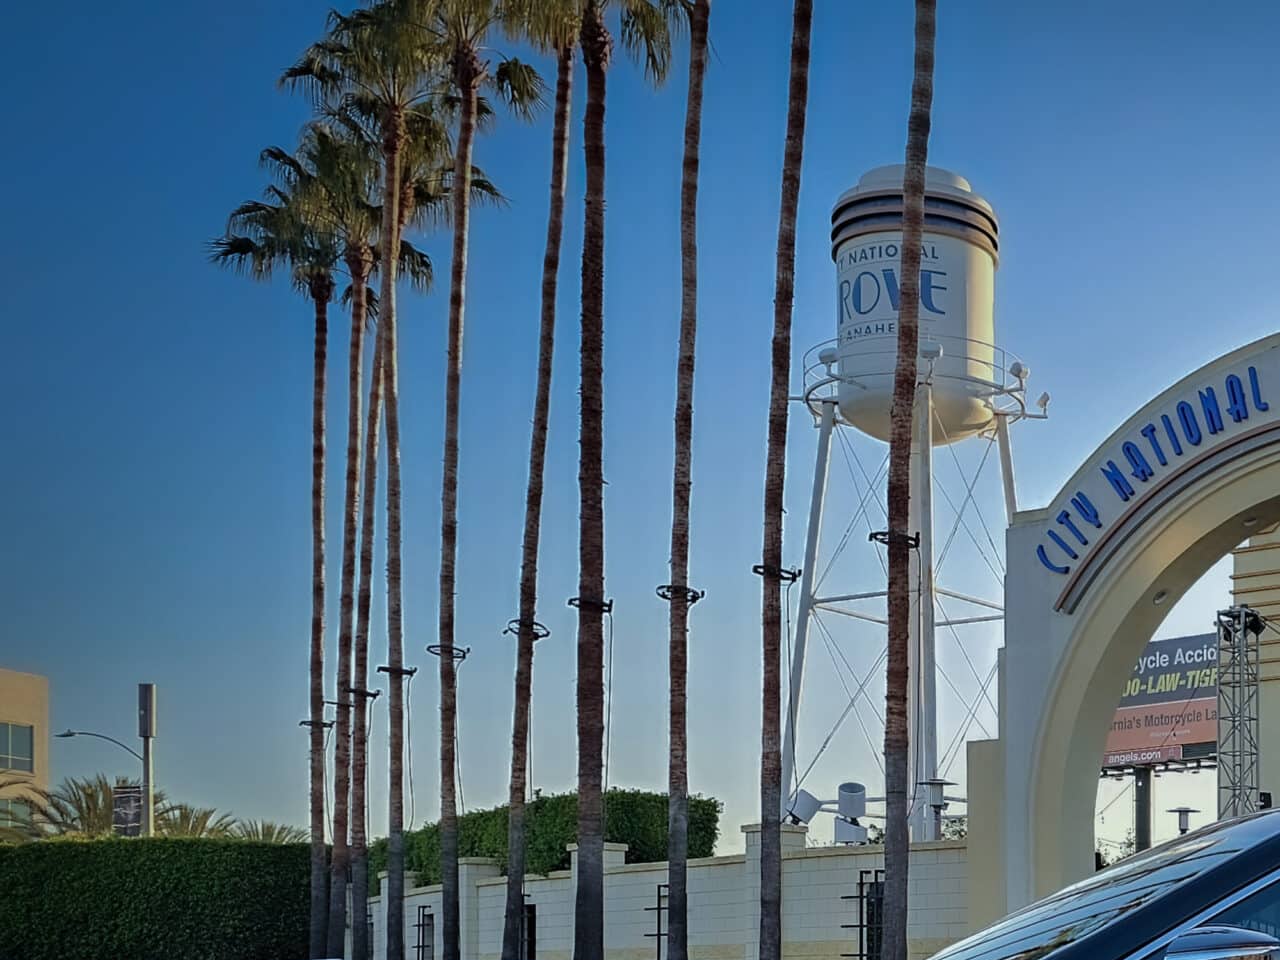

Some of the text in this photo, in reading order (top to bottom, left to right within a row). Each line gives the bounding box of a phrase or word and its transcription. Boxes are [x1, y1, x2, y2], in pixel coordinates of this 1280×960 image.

[849, 244, 939, 265] NATIOAL
[846, 323, 896, 341] ANAHE
[1036, 490, 1103, 575] CITY
[1100, 365, 1271, 502] NATIONAL
[1135, 651, 1168, 674] ycle
[1109, 714, 1142, 732] rnia's
[1144, 709, 1202, 730] Motorcycle
[1108, 749, 1161, 766] angels.com
